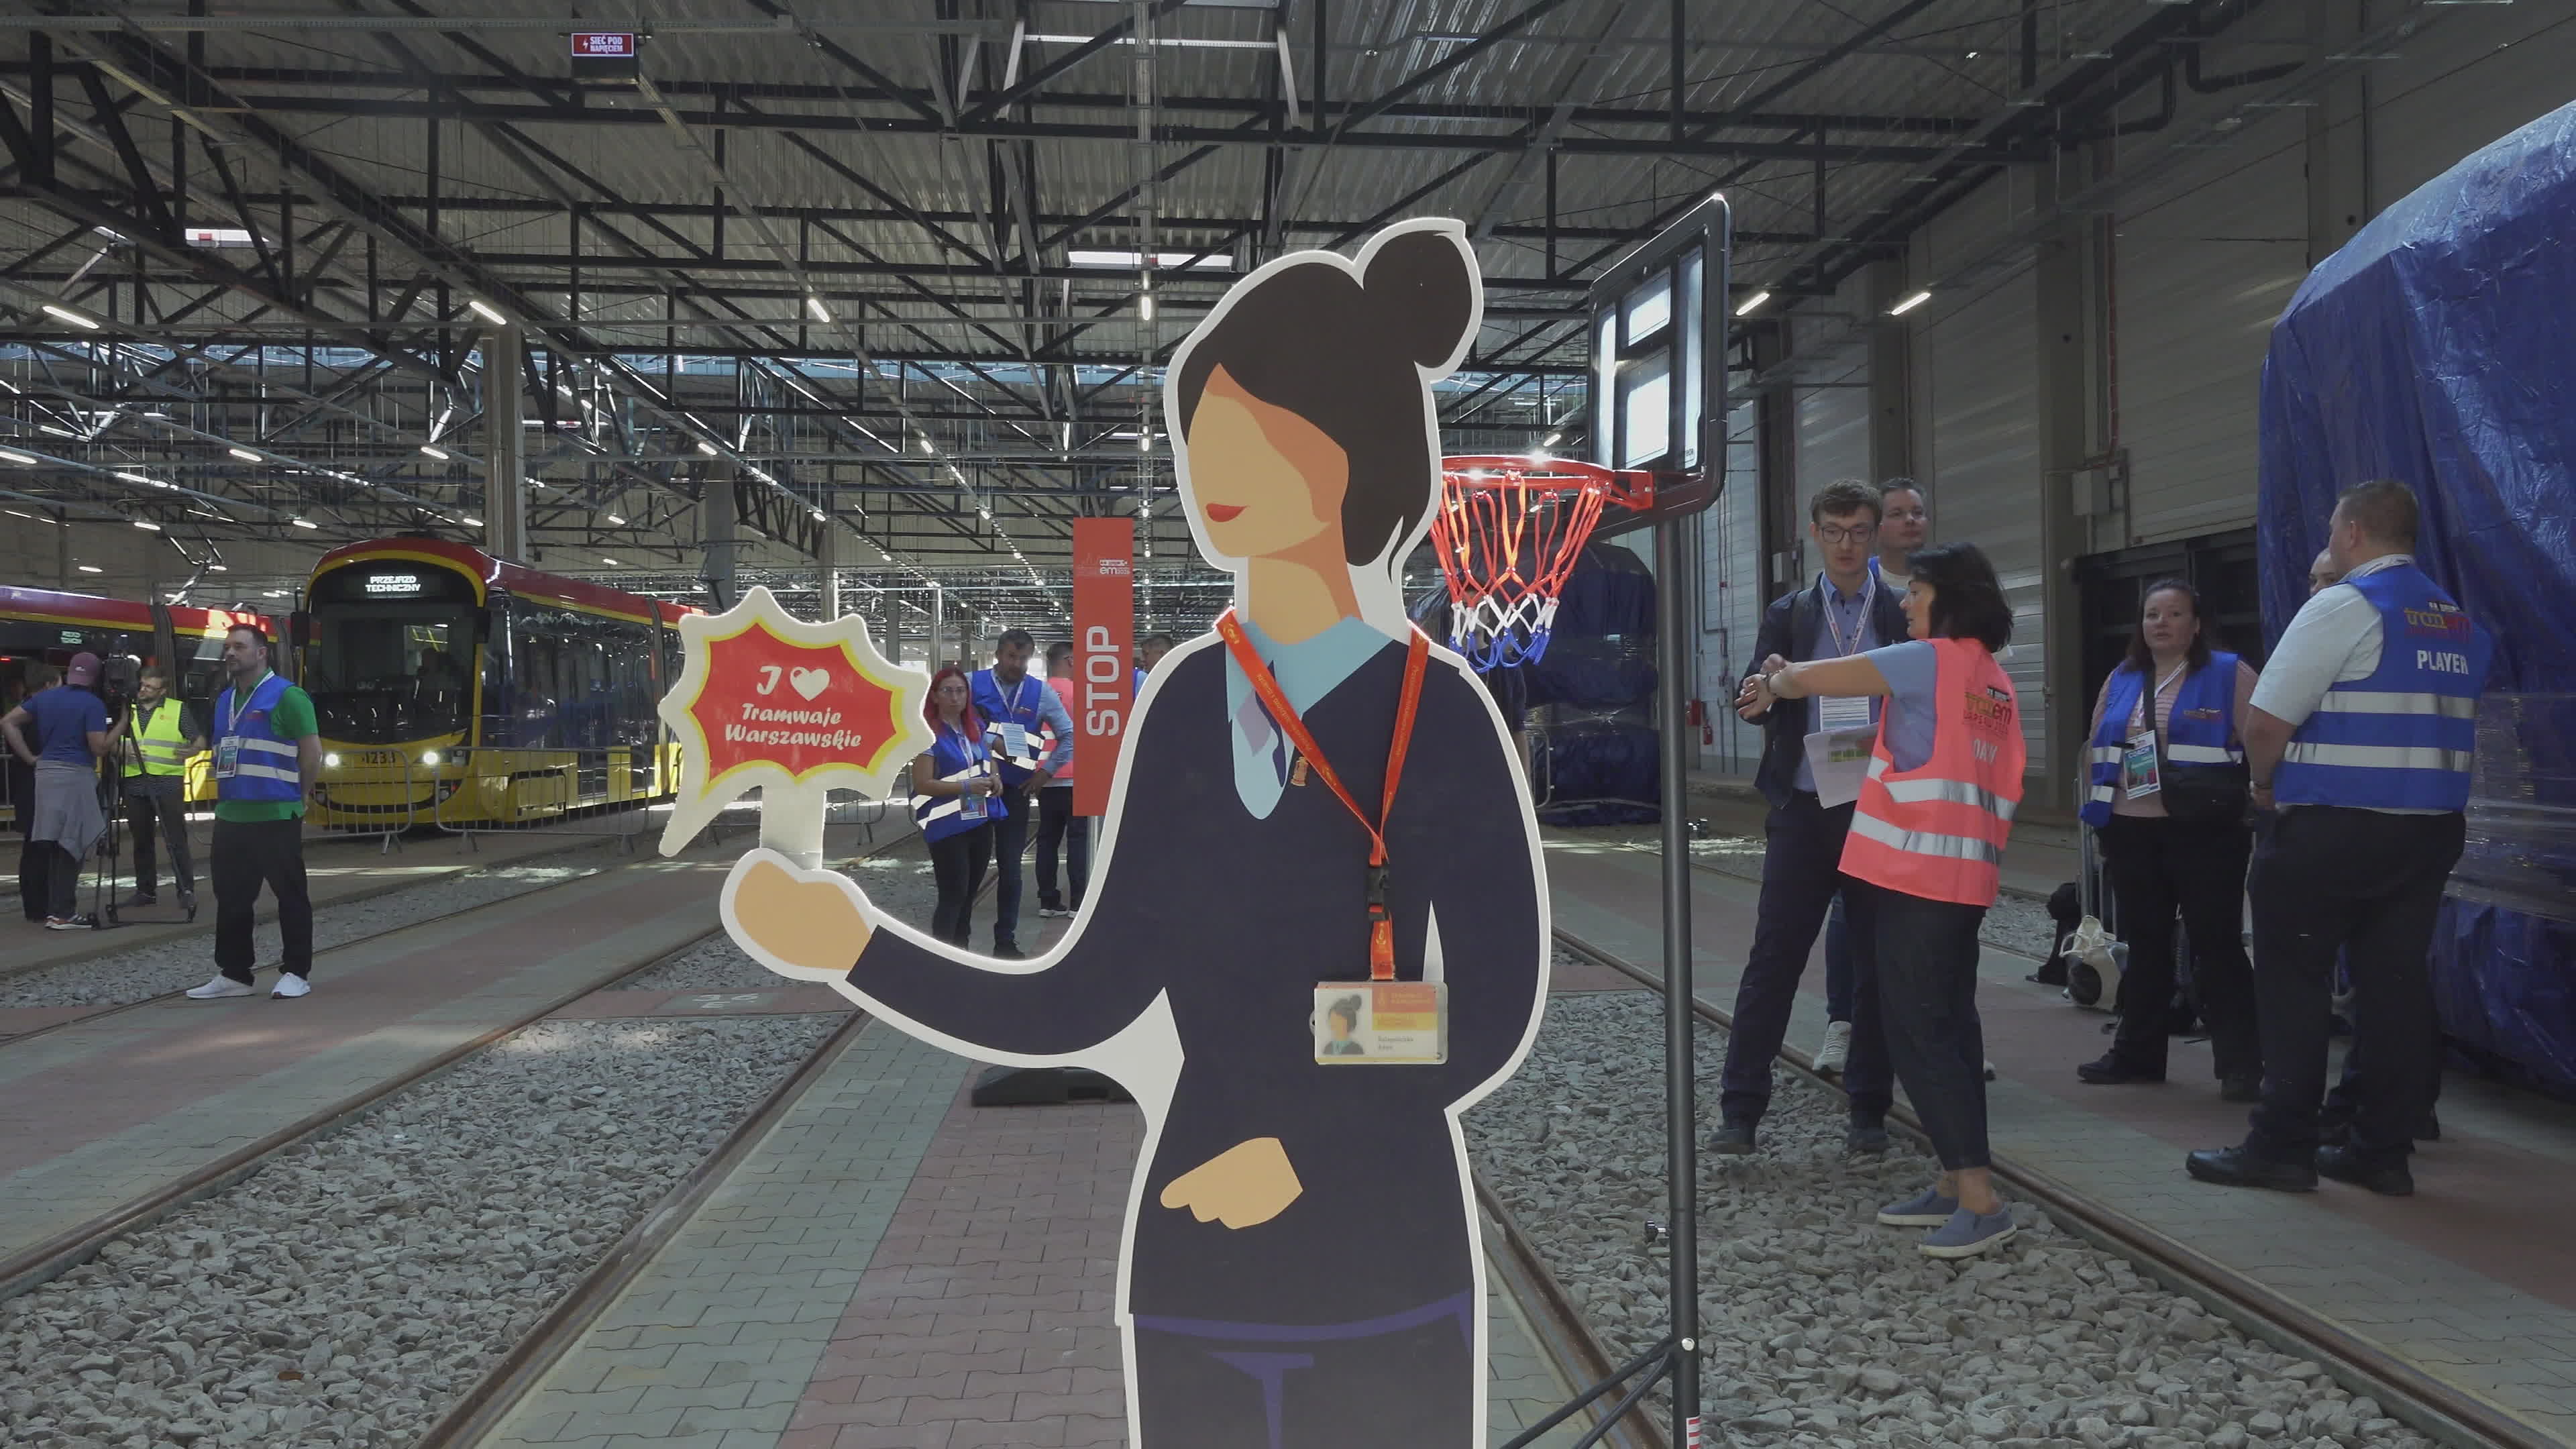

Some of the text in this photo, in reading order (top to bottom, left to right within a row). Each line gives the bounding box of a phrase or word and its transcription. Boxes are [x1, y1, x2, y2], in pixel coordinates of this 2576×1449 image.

[590, 35, 623, 45] SIEĆ POD
[590, 45, 623, 54] NAPIĘCIEM
[365, 584, 421, 592] TECHNICZNY
[2417, 649, 2469, 674] PLAYER
[1085, 625, 1120, 737] STOP
[742, 702, 841, 727] Tramwaje
[725, 724, 861, 751] Warszawskie
